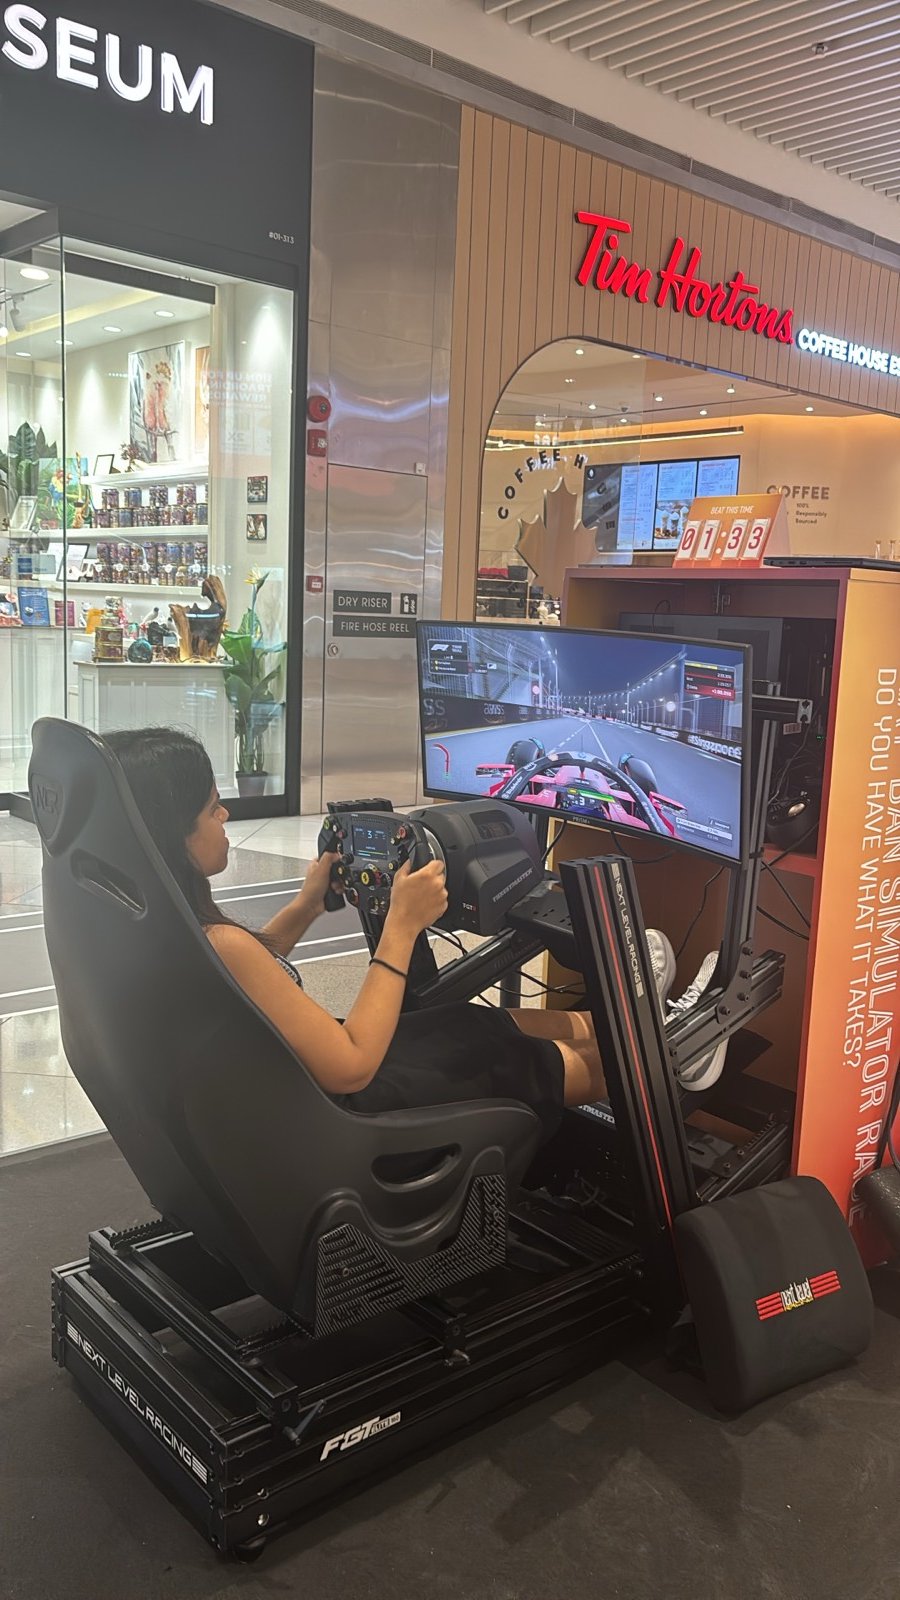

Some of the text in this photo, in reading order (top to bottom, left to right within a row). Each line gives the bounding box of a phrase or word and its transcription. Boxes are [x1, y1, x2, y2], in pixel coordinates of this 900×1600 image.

[1, 4, 215, 126] SEUM
[268, 231, 295, 245] #01-313
[575, 210, 653, 304] Tim
[798, 328, 848, 361] COFFEE
[848, 343, 889, 373] HOUSE
[498, 448, 561, 520] COFFEE
[710, 505, 755, 515] BEAT THIS TIME
[767, 484, 830, 500] COFFEE
[338, 596, 388, 608] DRY RISER
[340, 621, 410, 633] FIRE HOSE REEL
[842, 668, 897, 1068] DO YOU HAVE WHAT IT TAKES?
[614, 877, 641, 983] NEXT LEVEL RACING
[859, 878, 900, 1113] SIMULATOR
[77, 1333, 192, 1467] NEXT LEVEL RACING
[320, 1416, 381, 1462] FGT
